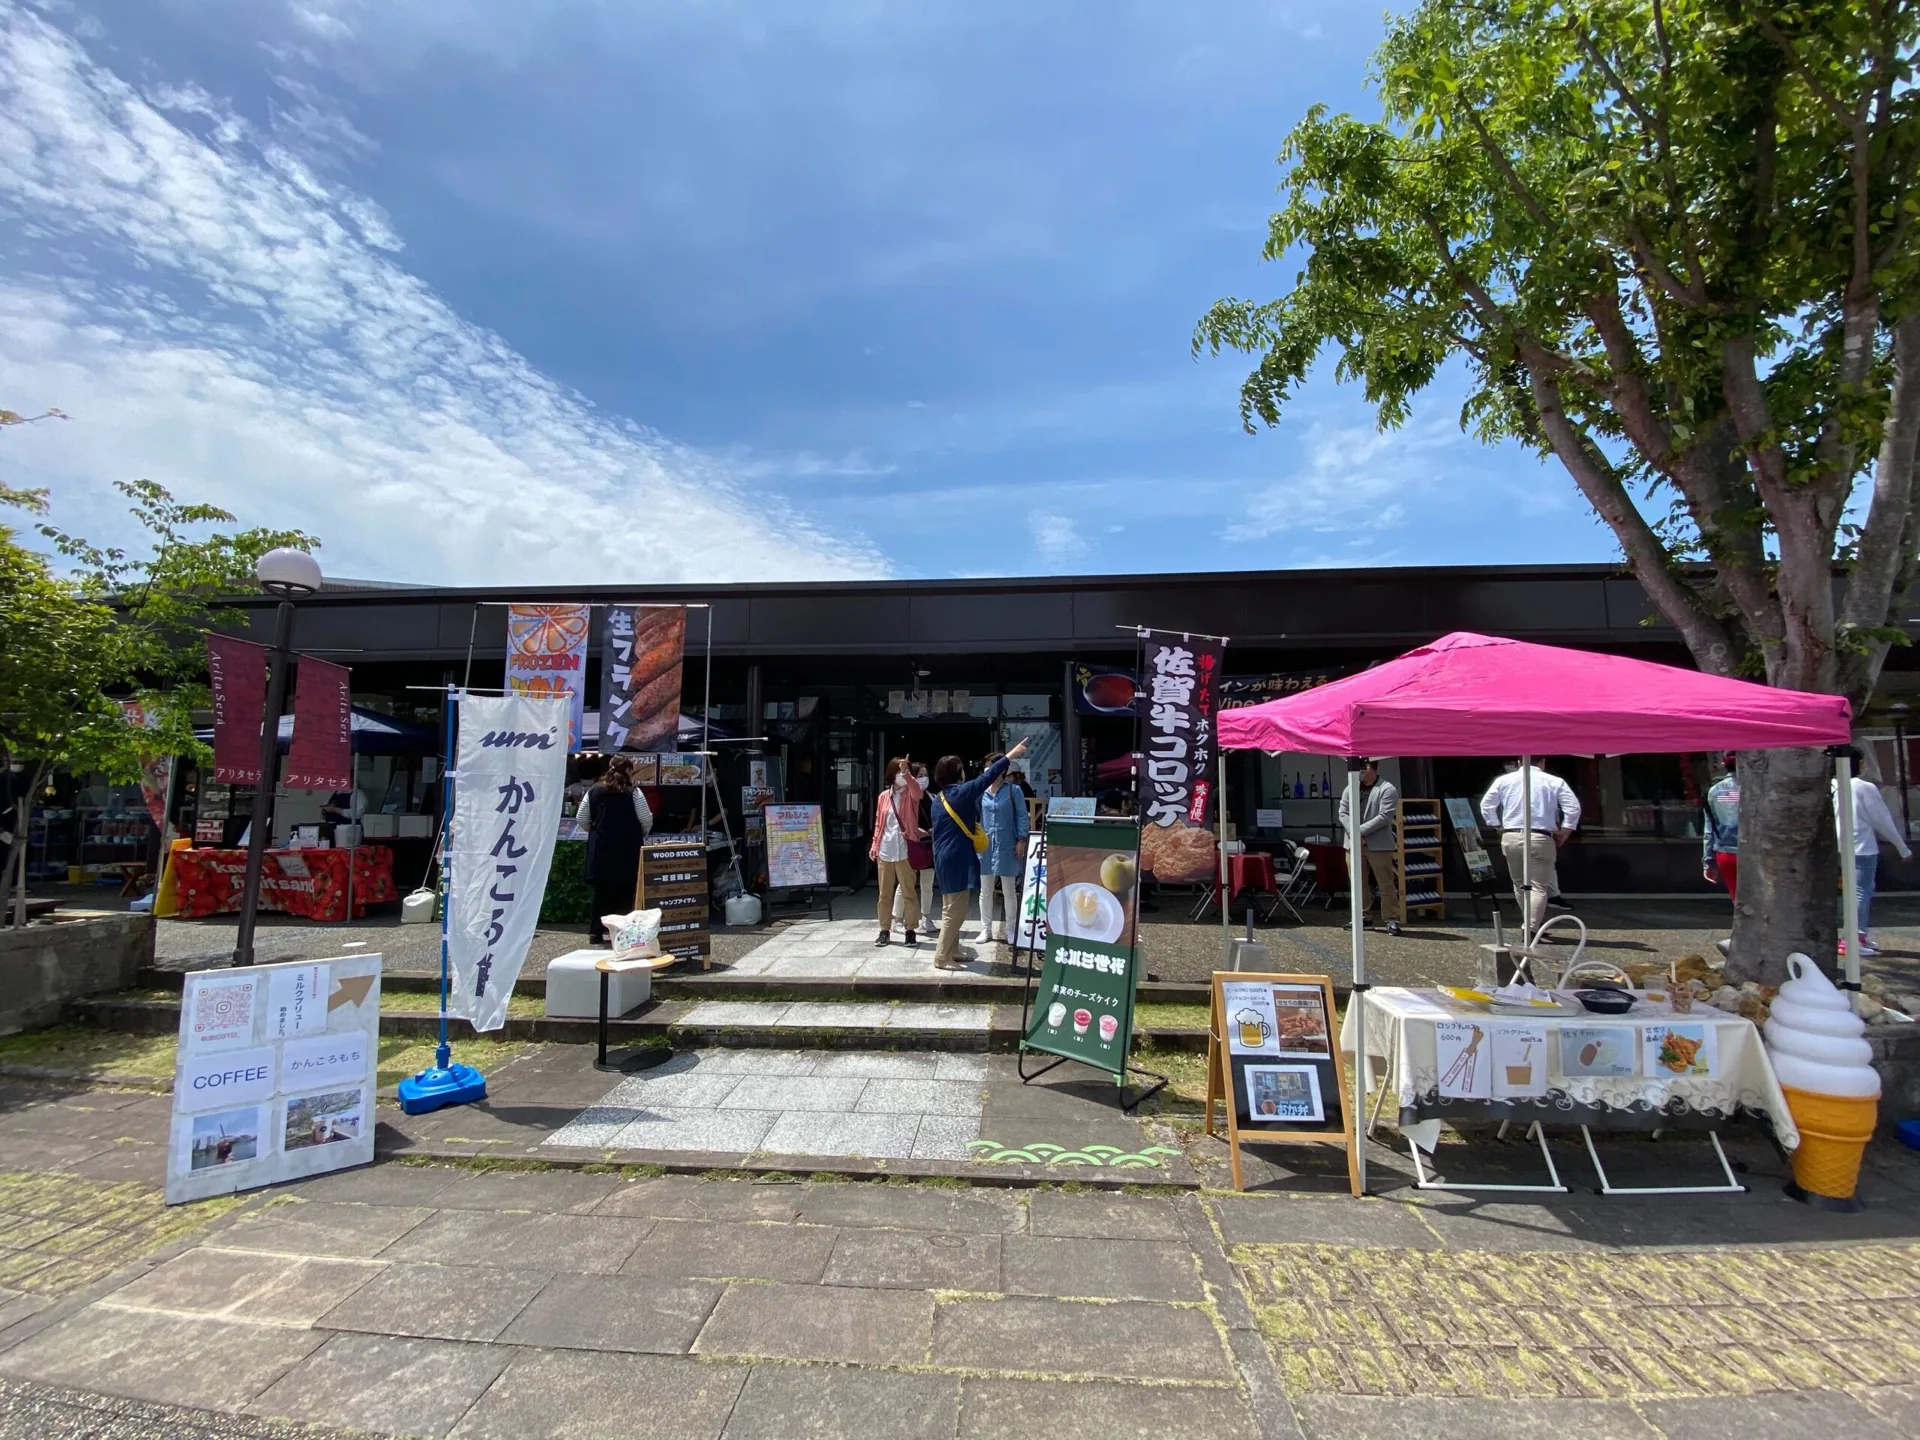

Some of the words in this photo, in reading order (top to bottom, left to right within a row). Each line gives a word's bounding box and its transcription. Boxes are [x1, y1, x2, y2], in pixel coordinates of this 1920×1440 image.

[509, 653, 580, 671] FROZEN
[606, 609, 633, 747] 生フランク
[478, 725, 558, 750] umi
[1147, 646, 1196, 828] 佐賀牛コロッケ
[217, 767, 261, 782] アリタセラ
[287, 774, 348, 788] アリタセラ
[1191, 784, 1207, 822] 味自慢
[776, 811, 810, 820] マルシェ
[676, 850, 699, 858] STOCK
[231, 875, 278, 889] frit
[659, 898, 697, 906] キャンプアイテム
[294, 974, 305, 1030] ミルクブリュー
[1052, 984, 1119, 1007] 果実のチーズケイク
[1440, 1034, 1462, 1042] 600円
[1497, 1028, 1532, 1036] ソフトクリーム
[291, 1050, 361, 1071] かんころもち
[1610, 1064, 1632, 1073] 700円
[193, 1066, 268, 1090] COFFEE
